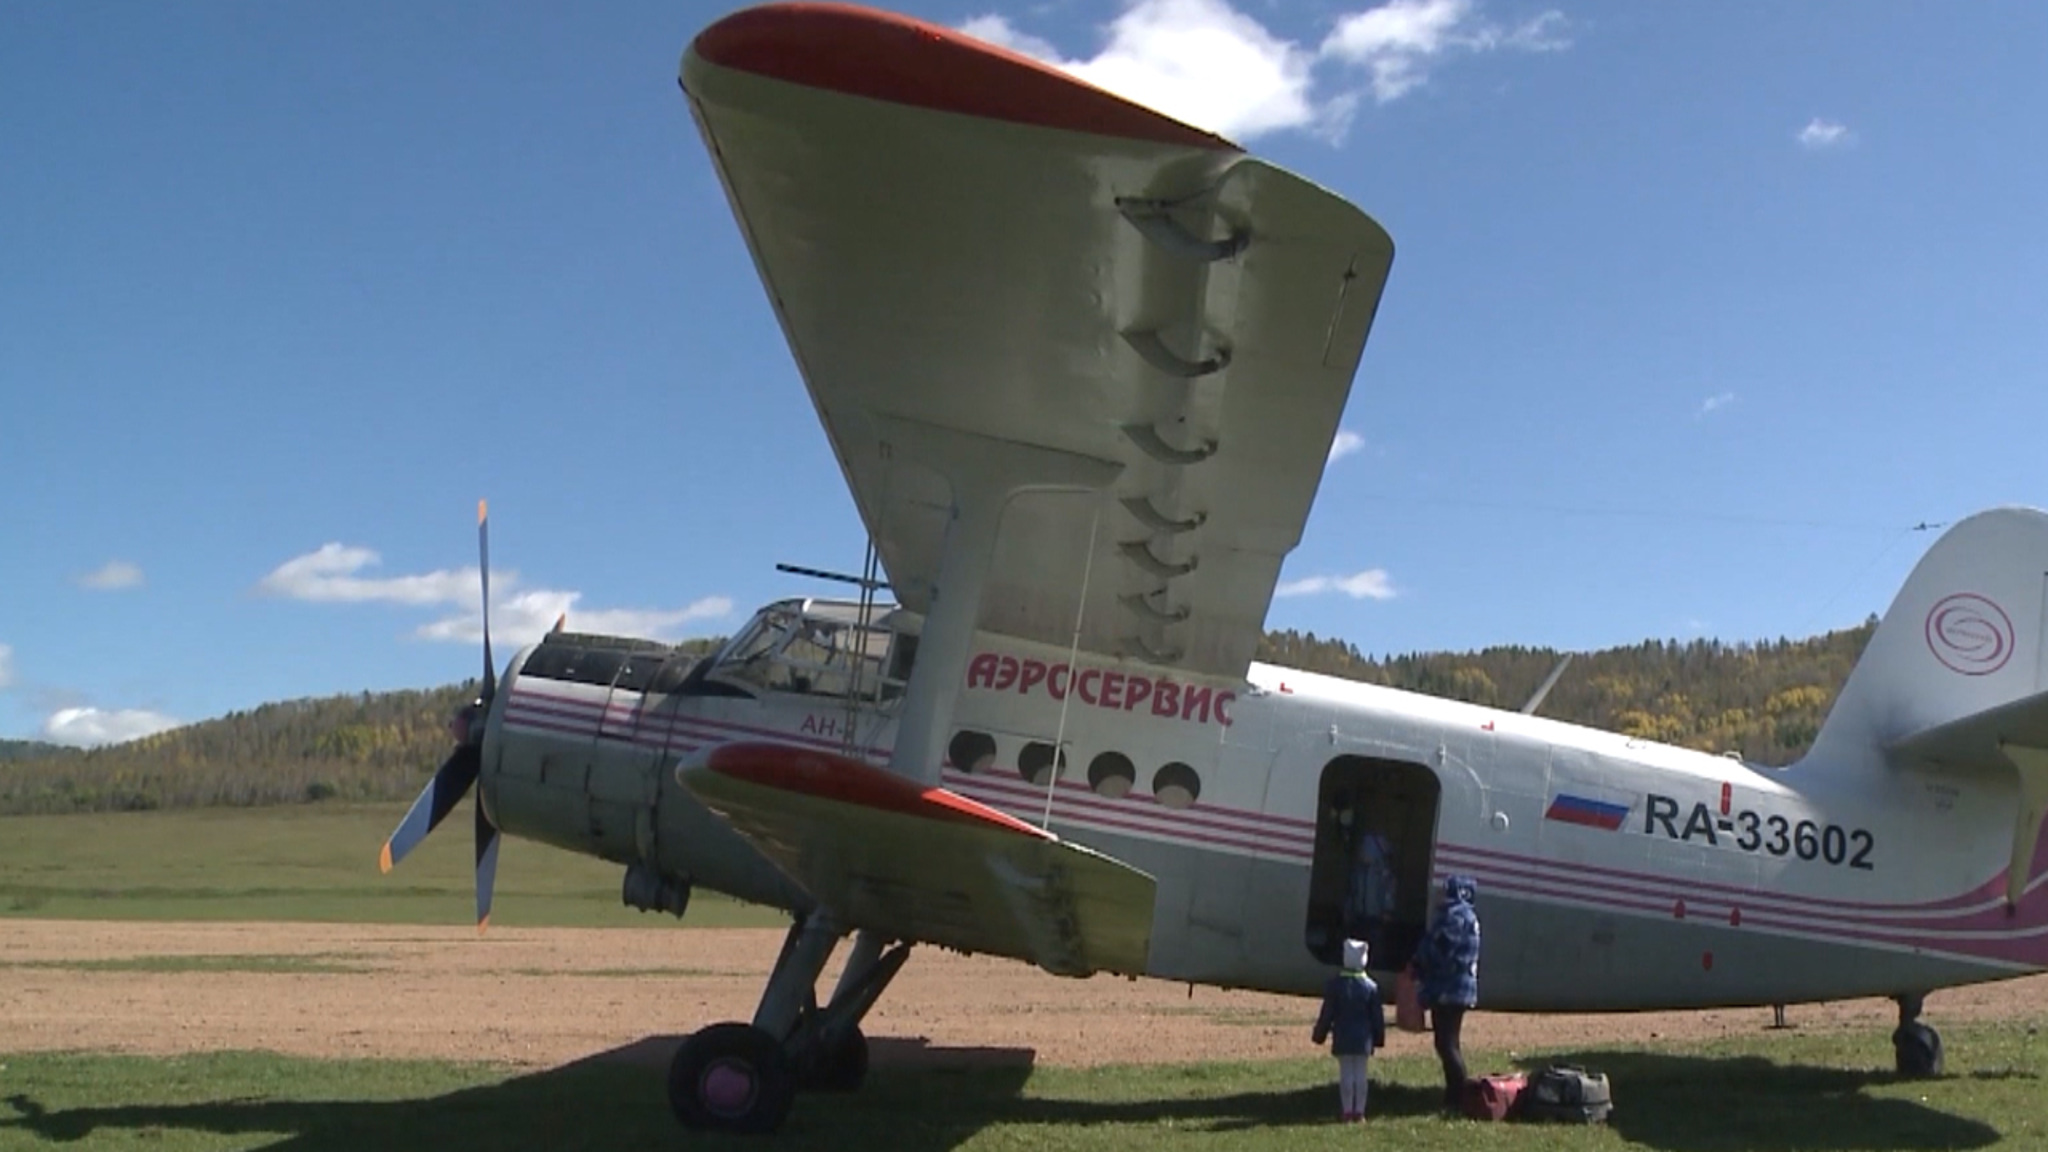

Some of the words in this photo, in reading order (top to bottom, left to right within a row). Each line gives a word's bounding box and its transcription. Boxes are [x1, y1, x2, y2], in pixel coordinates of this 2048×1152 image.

[801, 713, 854, 737] АН-
[968, 653, 1236, 727] АЭРОСЕРВИС
[1644, 793, 1874, 870] RA-33602
